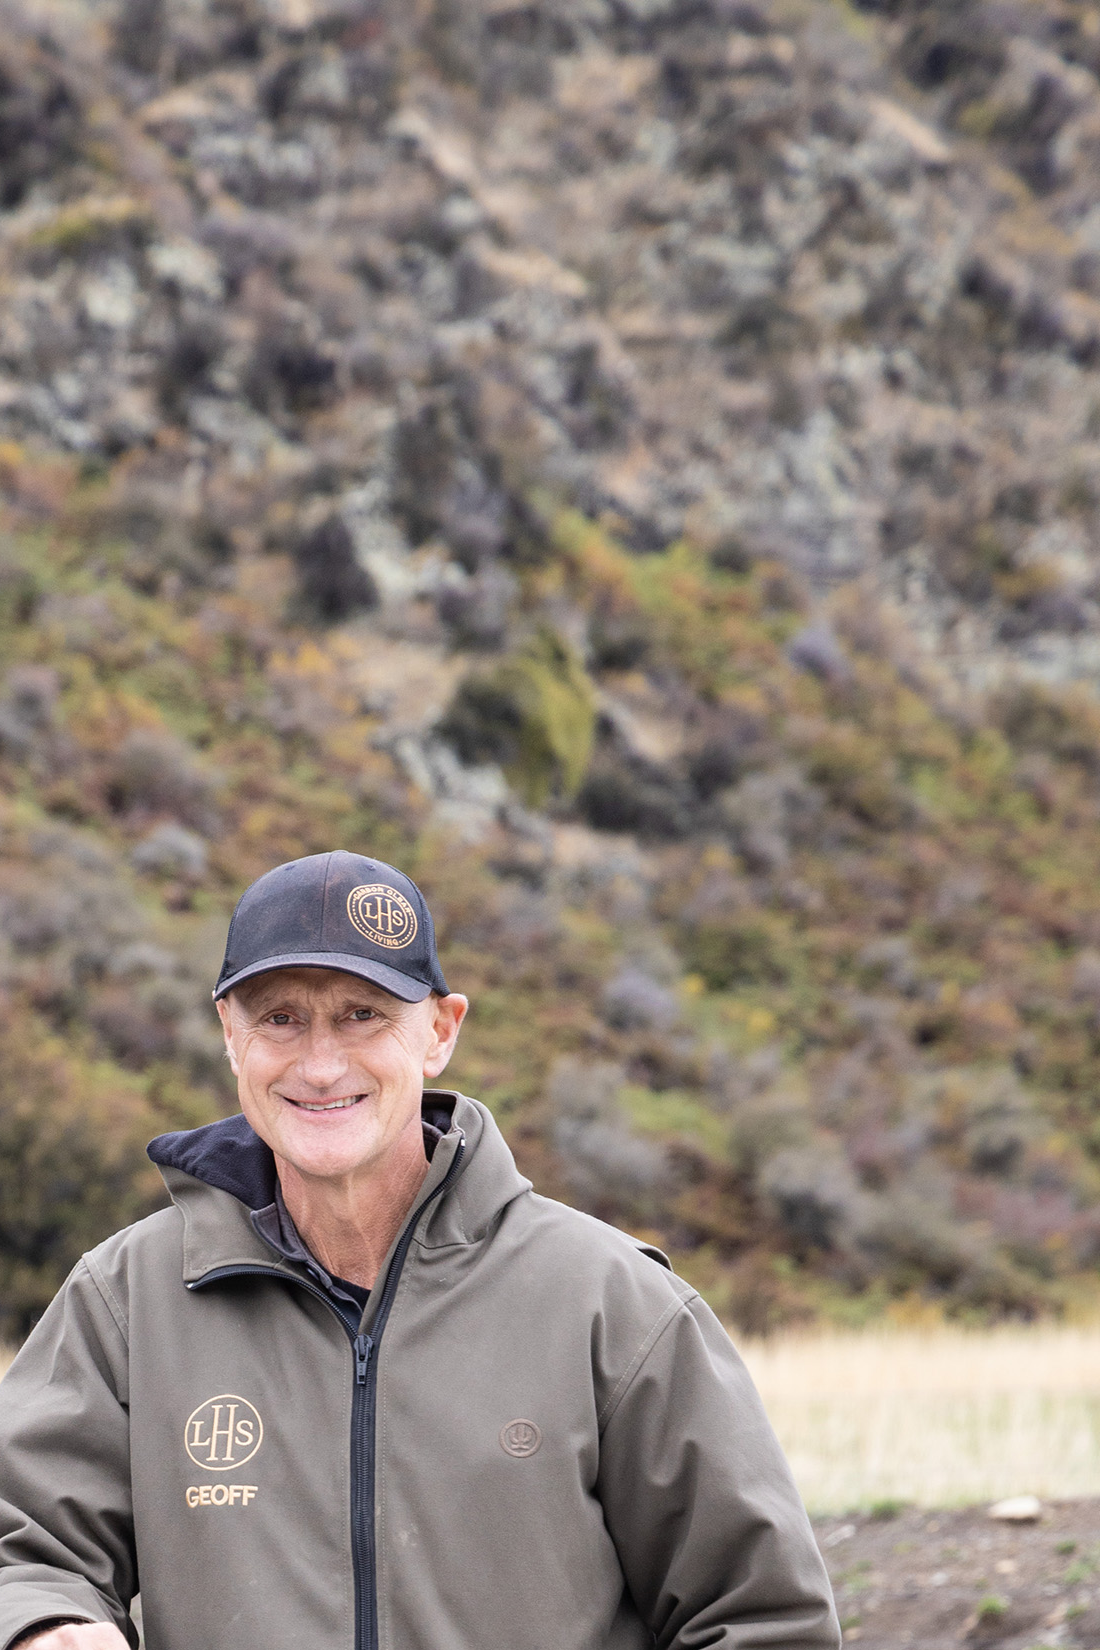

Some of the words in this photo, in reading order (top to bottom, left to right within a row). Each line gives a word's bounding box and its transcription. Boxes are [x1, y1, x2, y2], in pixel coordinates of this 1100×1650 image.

[363, 896, 404, 934] LHS
[368, 931, 399, 946] LIVING
[189, 1404, 254, 1461] LHS
[185, 1484, 259, 1508] GEOFF
